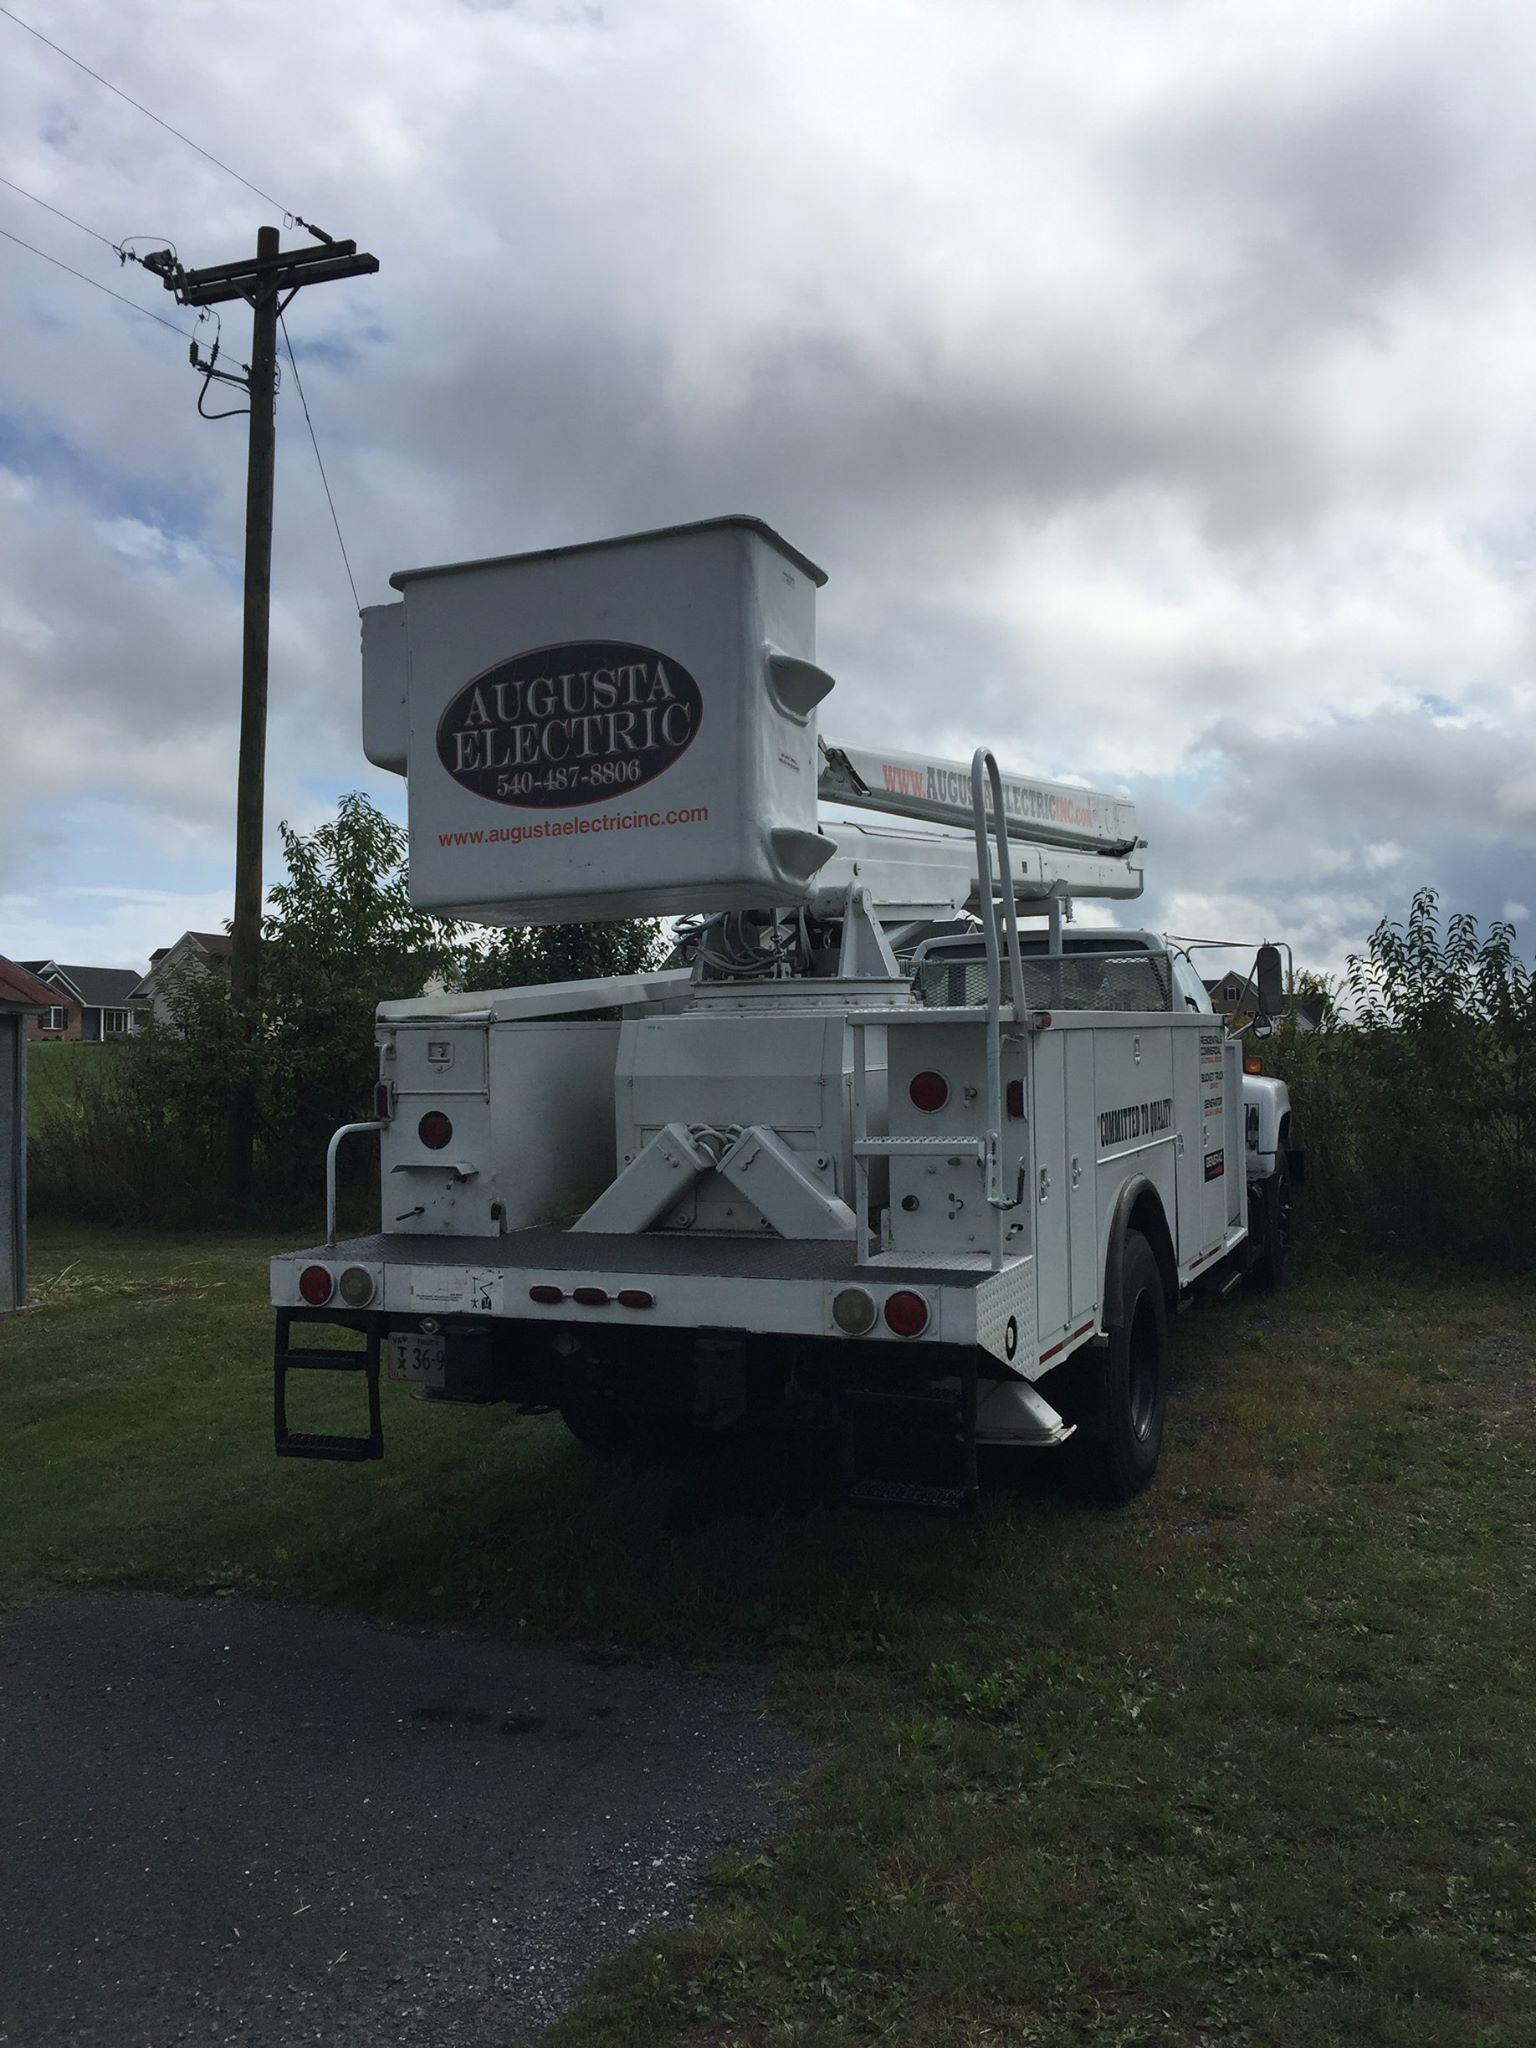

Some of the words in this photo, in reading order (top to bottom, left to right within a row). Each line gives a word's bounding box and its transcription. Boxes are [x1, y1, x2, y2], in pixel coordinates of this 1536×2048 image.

[463, 660, 676, 726] AUGUSTA
[452, 702, 692, 773] ELECTRIC
[496, 759, 641, 797] 540-487-8806
[438, 807, 709, 847] www.augustaelectricinc.com
